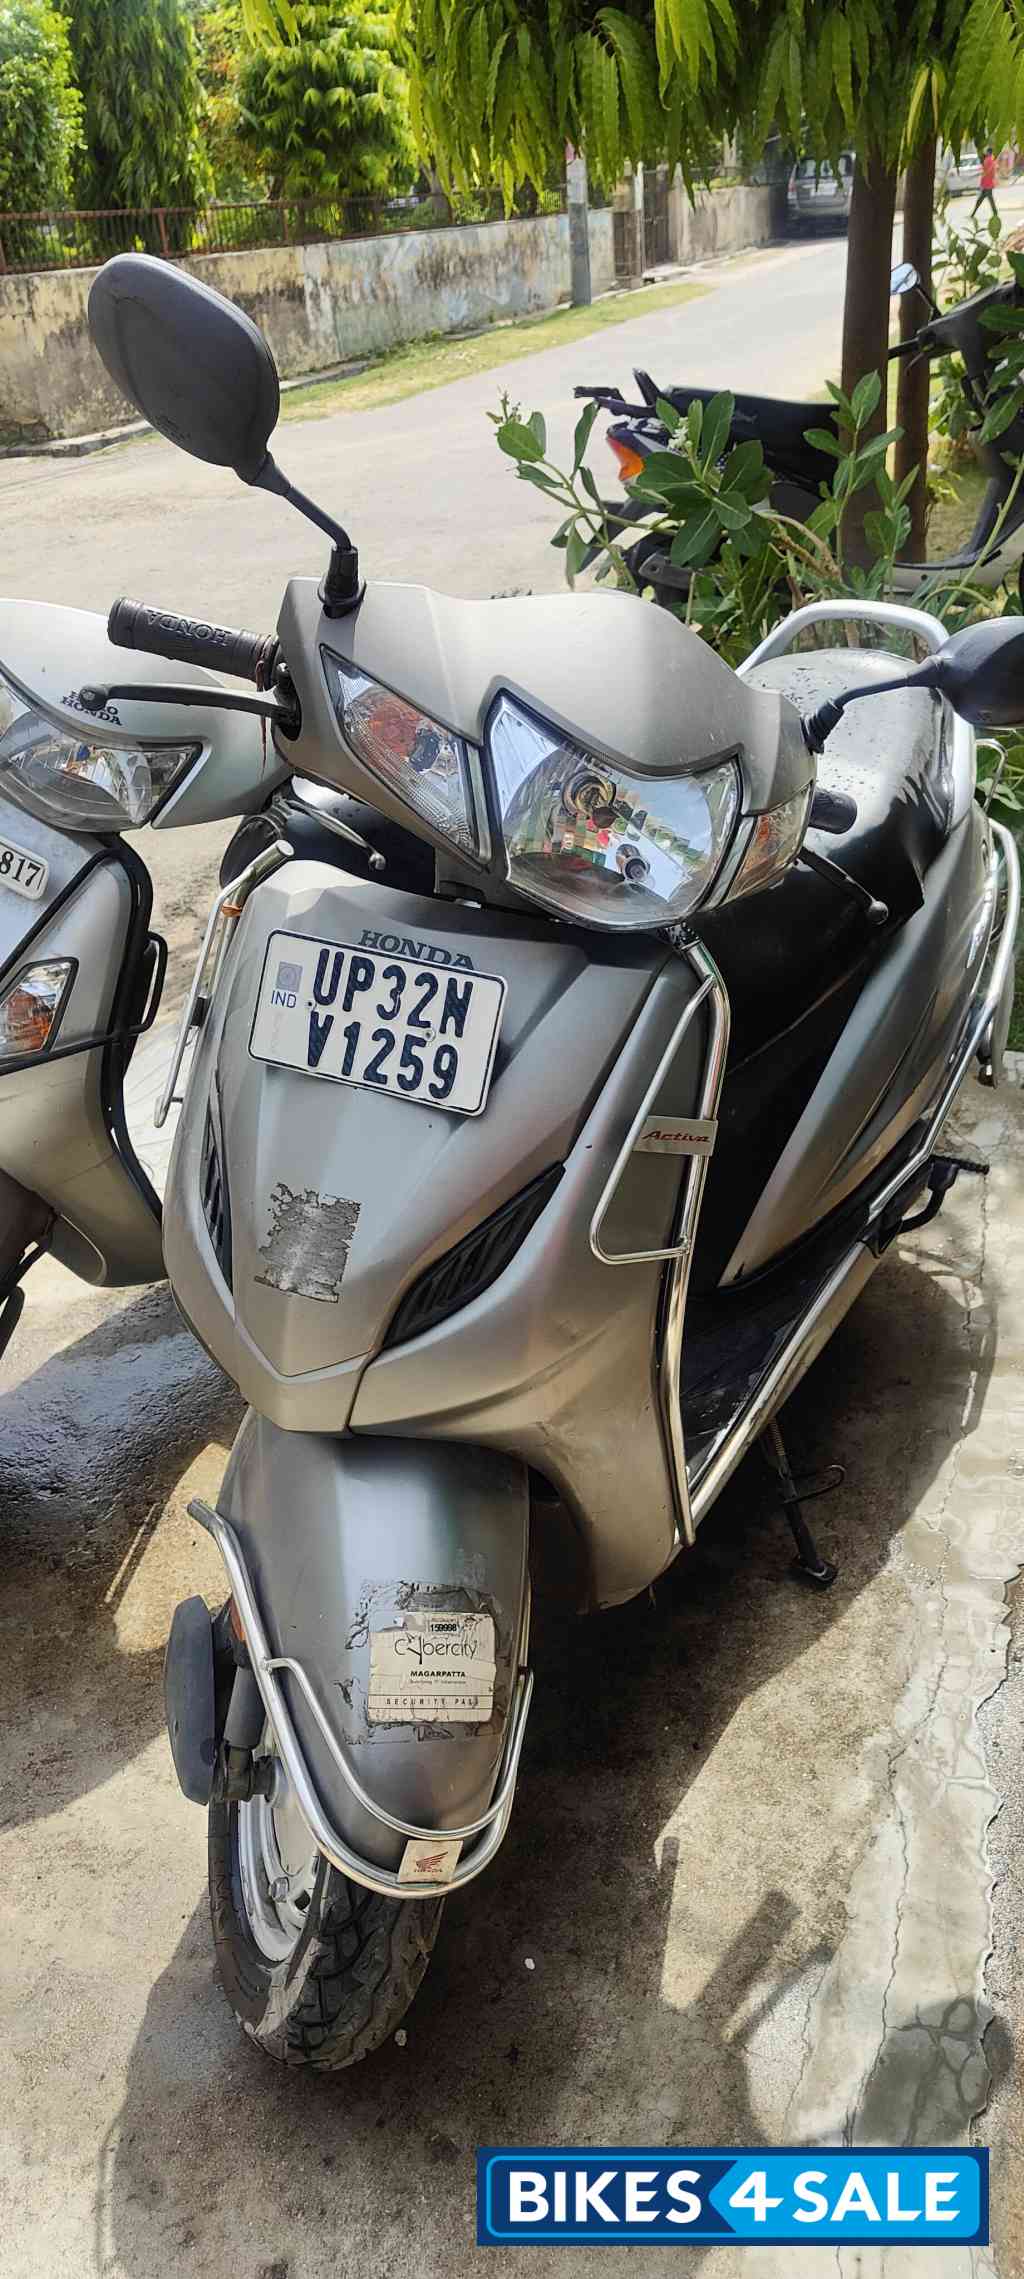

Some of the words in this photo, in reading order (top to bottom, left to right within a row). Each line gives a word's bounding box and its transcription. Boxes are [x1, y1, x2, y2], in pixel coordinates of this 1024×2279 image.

[145, 608, 232, 646] HONDA
[358, 929, 474, 970] HONDA
[270, 989, 297, 1009] IND
[312, 948, 474, 1038] UP32N
[307, 1010, 459, 1099] V1259
[642, 1130, 711, 1143] Activa
[410, 1670, 467, 1678] MAGARPATTA
